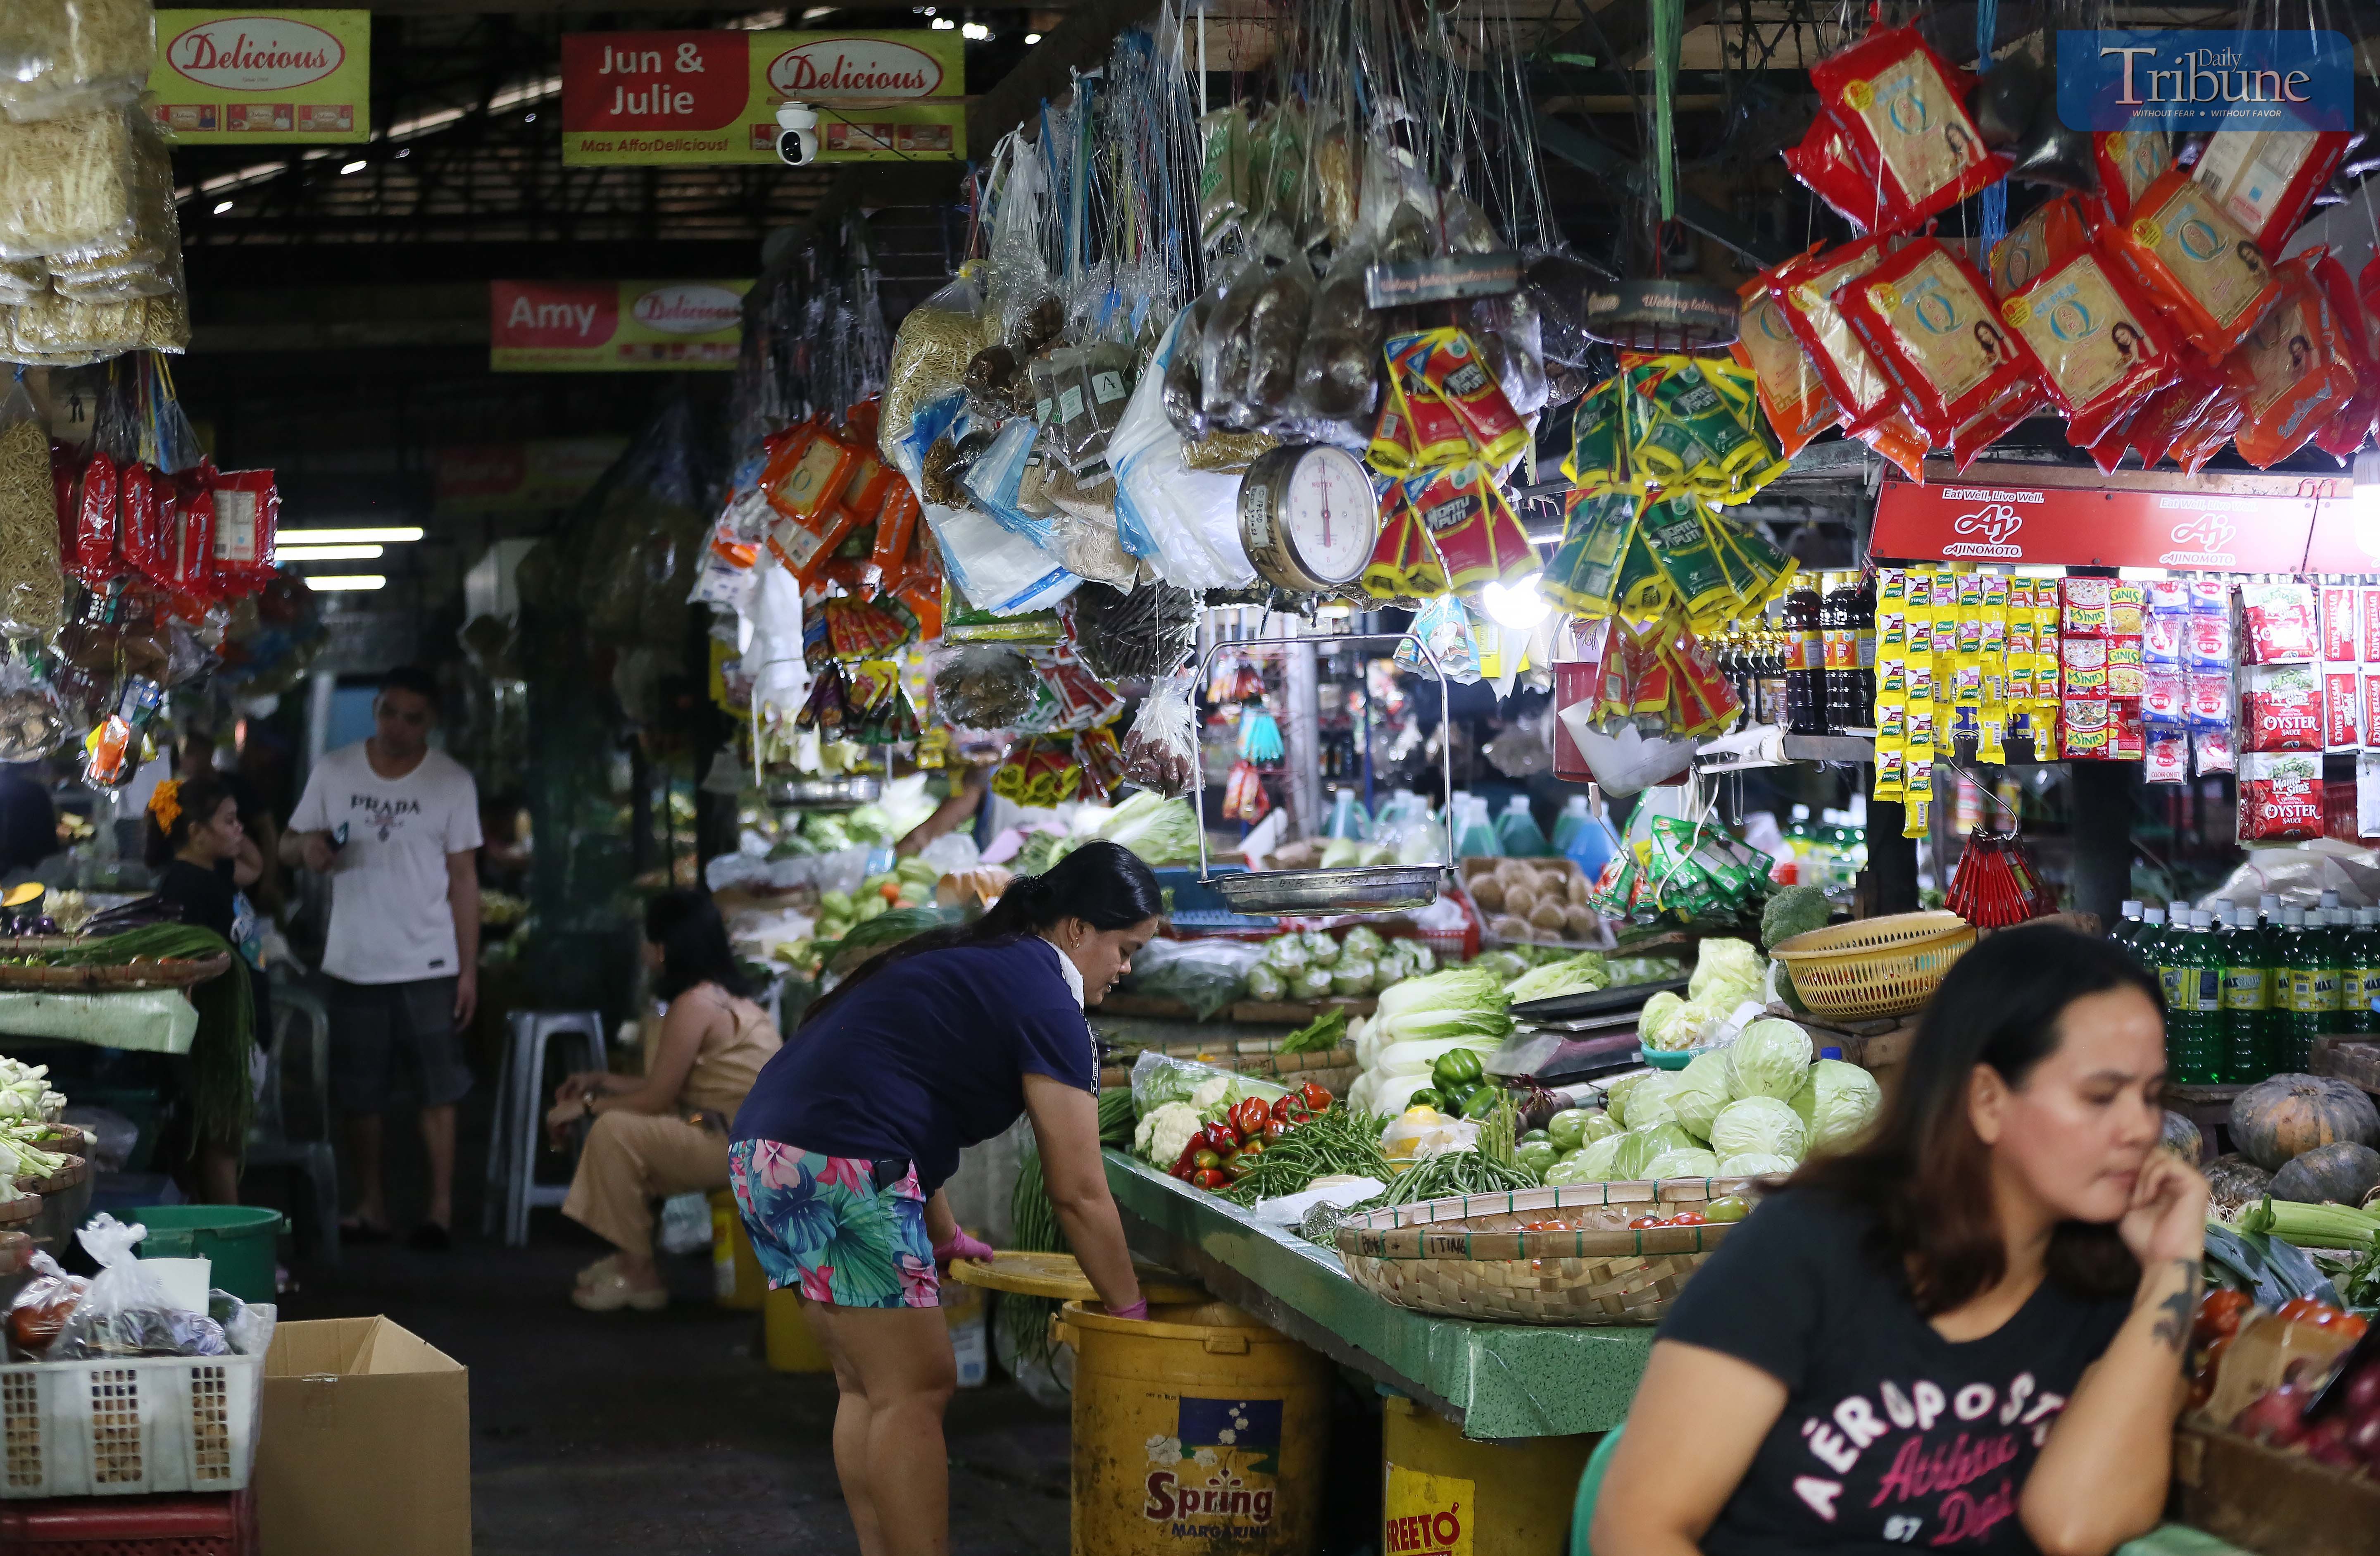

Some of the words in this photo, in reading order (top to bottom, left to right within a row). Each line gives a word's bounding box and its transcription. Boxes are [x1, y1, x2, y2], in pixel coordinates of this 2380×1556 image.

[183, 33, 329, 69] Delicious
[599, 45, 661, 75] Jun
[674, 42, 705, 74] &
[782, 53, 928, 91] Delicious
[609, 85, 695, 116] Julie
[580, 138, 613, 153] Mas
[507, 296, 597, 337] Amy
[1944, 489, 1962, 499] Eat
[1964, 490, 1991, 502] Well,
[1993, 491, 2015, 501] Live
[2017, 492, 2044, 503] Well.
[2161, 498, 2178, 508] Eat
[2181, 499, 2206, 510] Well,
[2209, 500, 2230, 510] Live
[1944, 545, 2021, 556] AJINOMOTO
[2161, 553, 2234, 564] AJINOMOTO
[2328, 594, 2337, 629] OYSTER
[2331, 630, 2340, 659] SAUCE
[2371, 631, 2380, 660] SAUCE
[2068, 671, 2104, 684] GINISA
[2370, 680, 2380, 713] OYSTER
[2264, 715, 2320, 732] OYSTER
[2330, 679, 2340, 712] OYSTER
[2335, 715, 2344, 743] SAUCE
[2273, 777, 2301, 792] Mama
[351, 793, 421, 815] PRADA
[2265, 804, 2322, 820] OYSTER
[2282, 817, 2302, 825] SAUCE
[1793, 1371, 2066, 1522] AÉROPOST
[1145, 1471, 1274, 1525] Spring
[1171, 1523, 1268, 1538] MARGARINE
